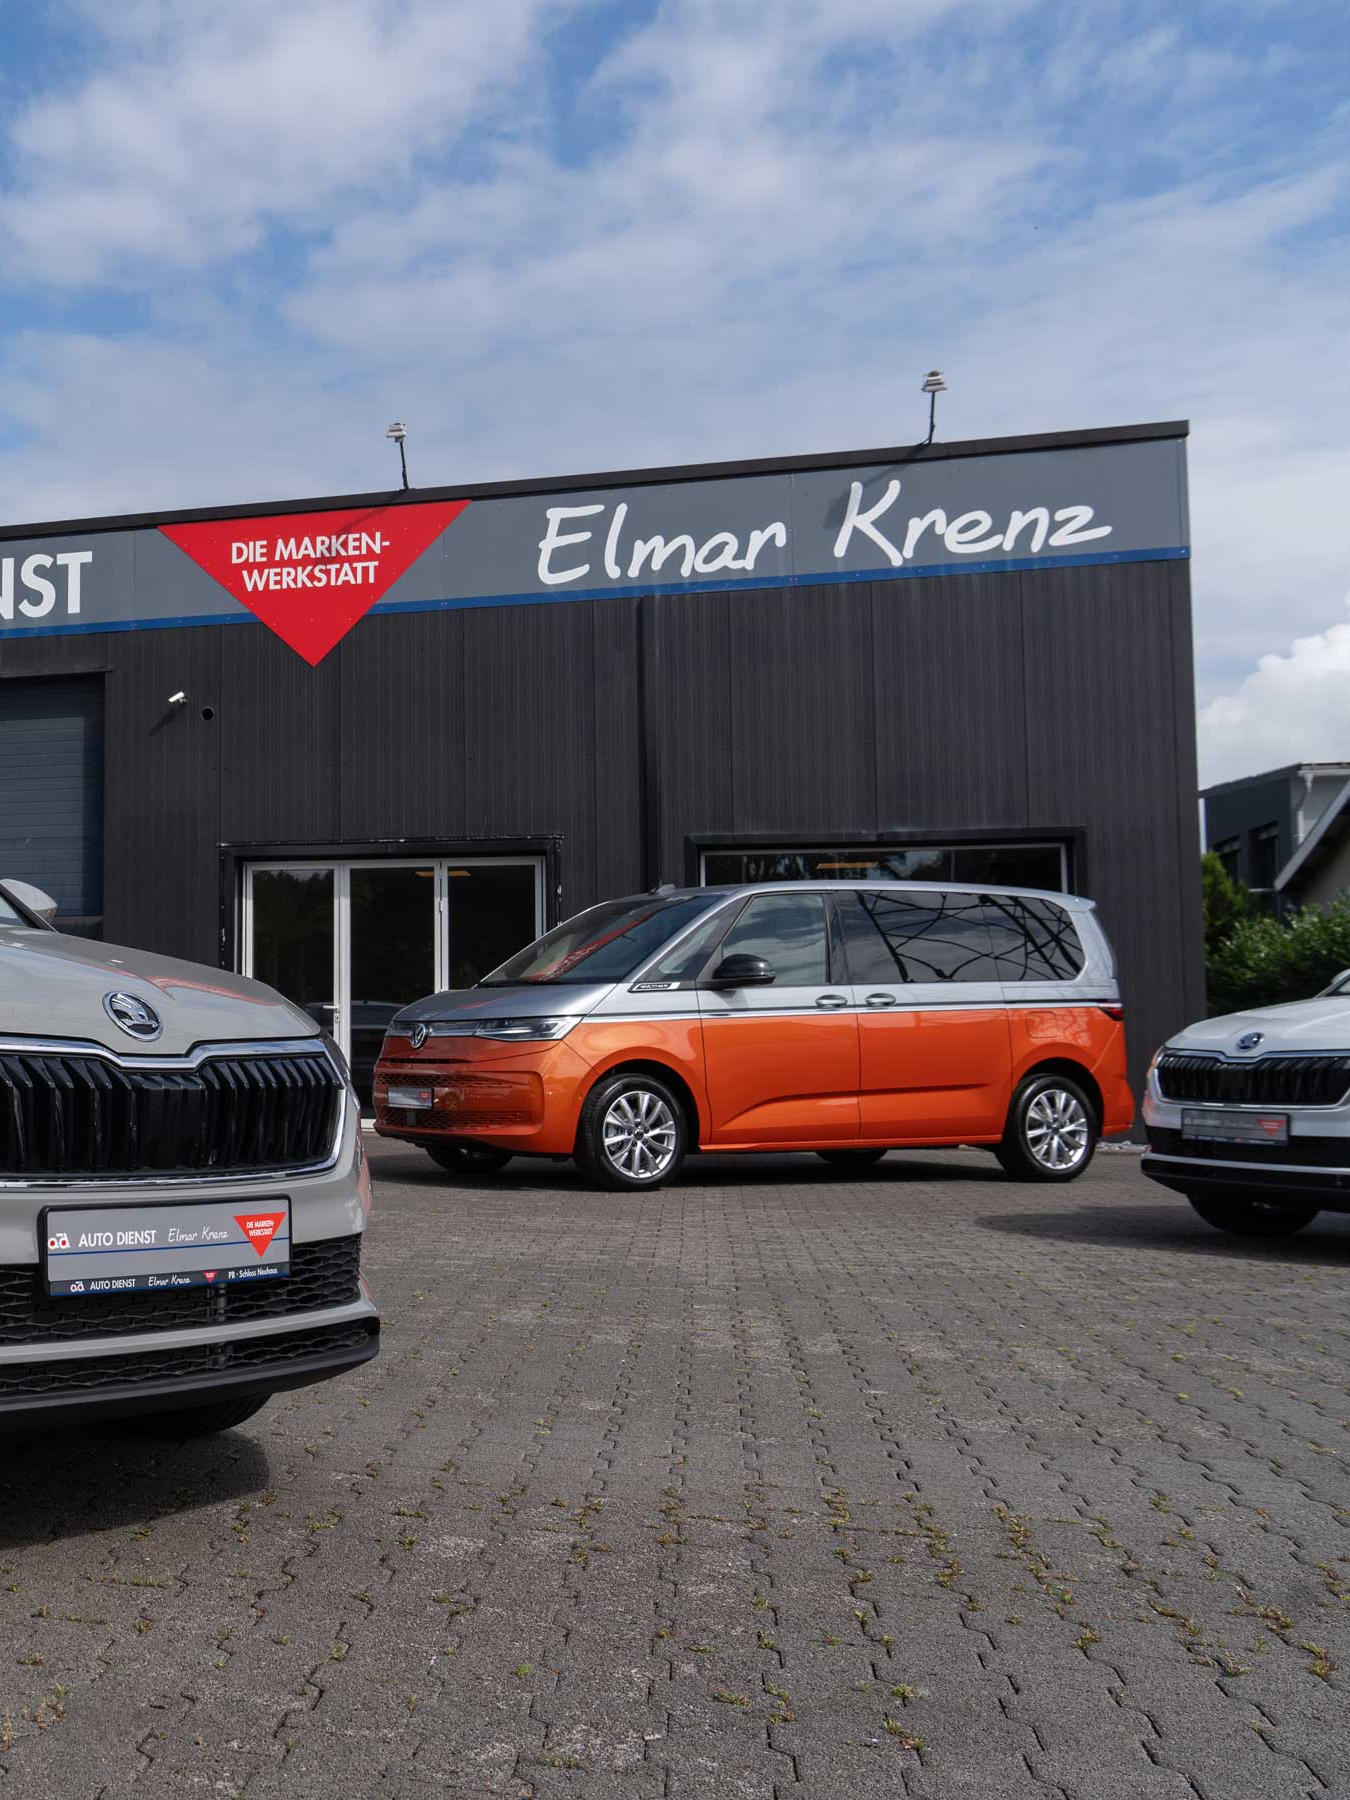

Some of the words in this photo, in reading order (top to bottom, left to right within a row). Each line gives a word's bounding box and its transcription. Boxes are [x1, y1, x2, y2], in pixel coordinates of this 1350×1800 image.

[538, 503, 786, 584] Elmar
[833, 479, 1113, 567] Krenz
[231, 540, 267, 564] DIE
[274, 531, 390, 561] MARKEN-
[242, 561, 379, 592] WERKSTATT
[78, 1231, 113, 1248] AUTO
[116, 1230, 157, 1246] DIENST
[168, 1228, 198, 1242] Elmar
[201, 1225, 230, 1241] Krenz
[90, 1279, 111, 1290] AUTO
[111, 1278, 136, 1289] DIENST
